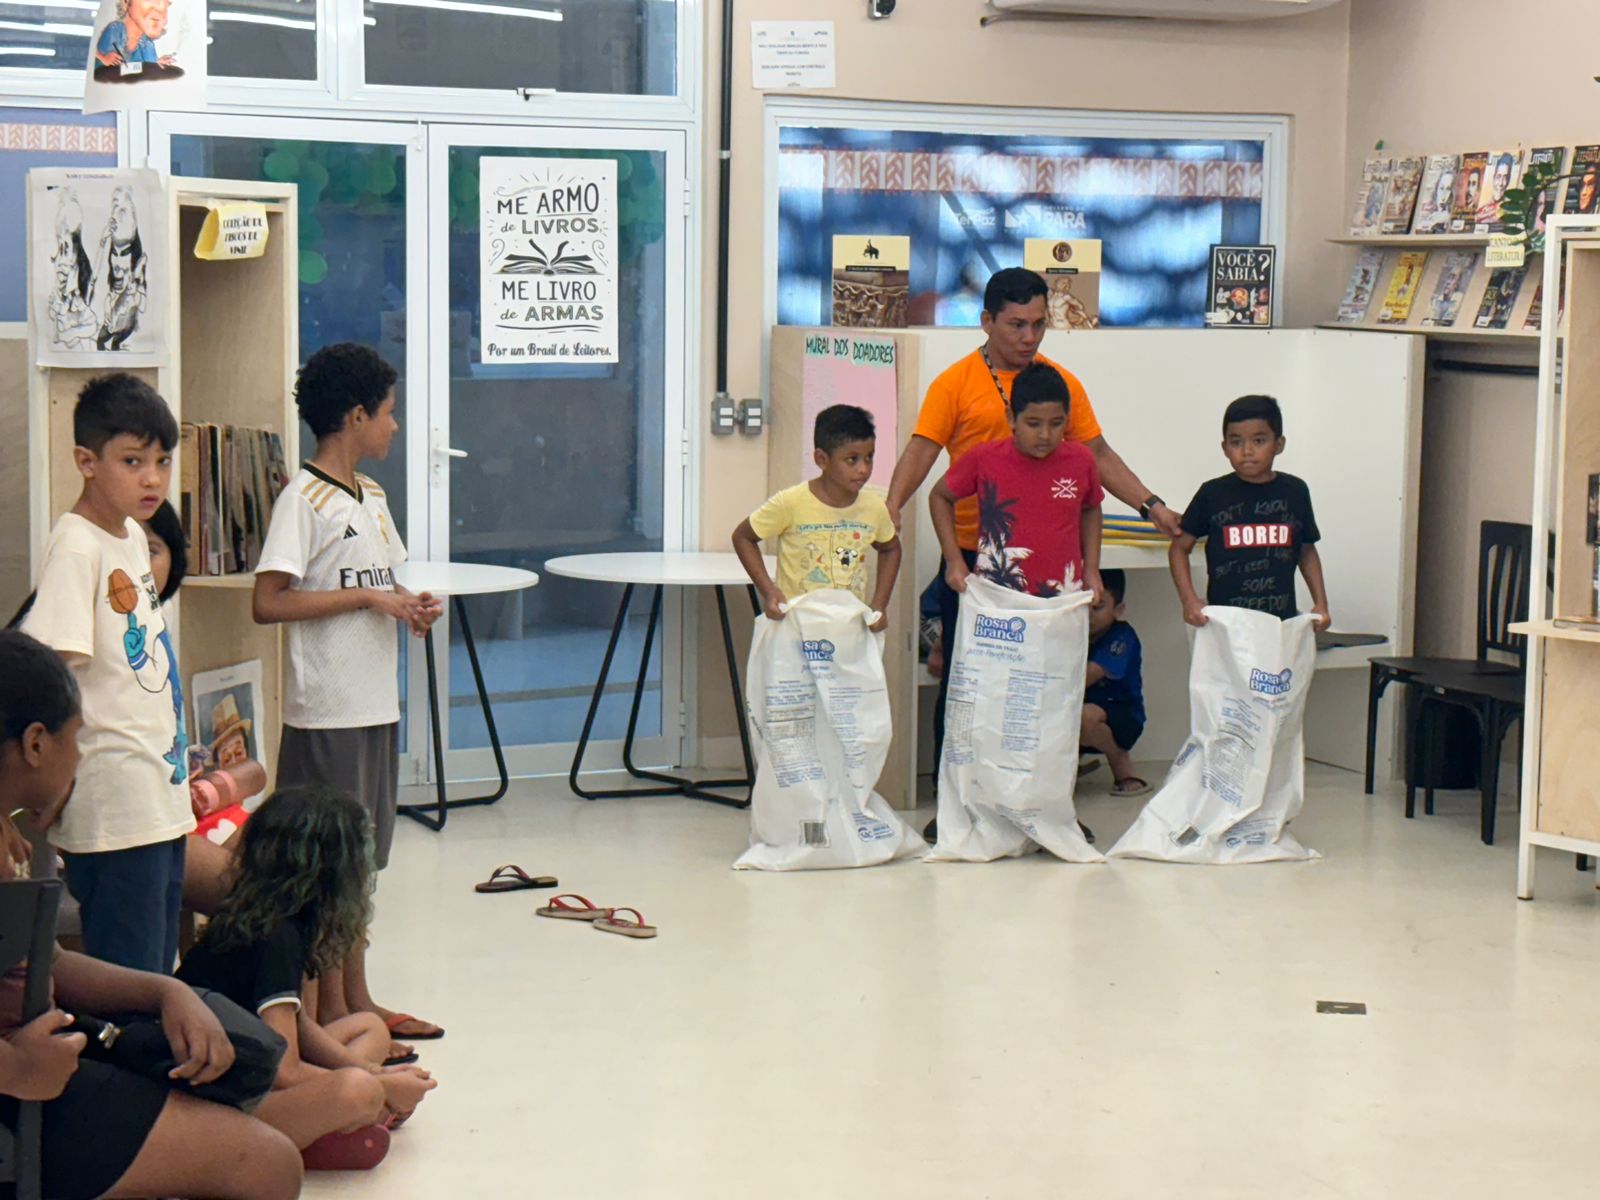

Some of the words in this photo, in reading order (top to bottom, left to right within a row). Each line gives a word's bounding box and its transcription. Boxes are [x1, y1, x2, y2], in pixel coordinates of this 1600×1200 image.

[497, 196, 528, 215] ME
[536, 182, 599, 214] ARMO
[500, 222, 516, 233] de
[521, 218, 599, 235] LIVROS
[1217, 249, 1256, 267] VOCÊ
[502, 280, 529, 301] ME
[536, 280, 597, 301] LIVRO
[500, 309, 518, 320] de
[524, 305, 604, 322] ARMAS
[487, 342, 508, 356] Por
[510, 347, 525, 356] um
[527, 342, 557, 356] Brasil
[560, 343, 570, 356] de
[805, 336, 830, 355] MURAL
[833, 337, 849, 356] DOS
[853, 342, 894, 364] DOADORES
[1229, 525, 1289, 546] BORED
[976, 614, 1009, 631] Rosa
[975, 626, 1024, 642] Branca
[1251, 668, 1280, 684] Rosa
[1250, 680, 1291, 694] Branca
